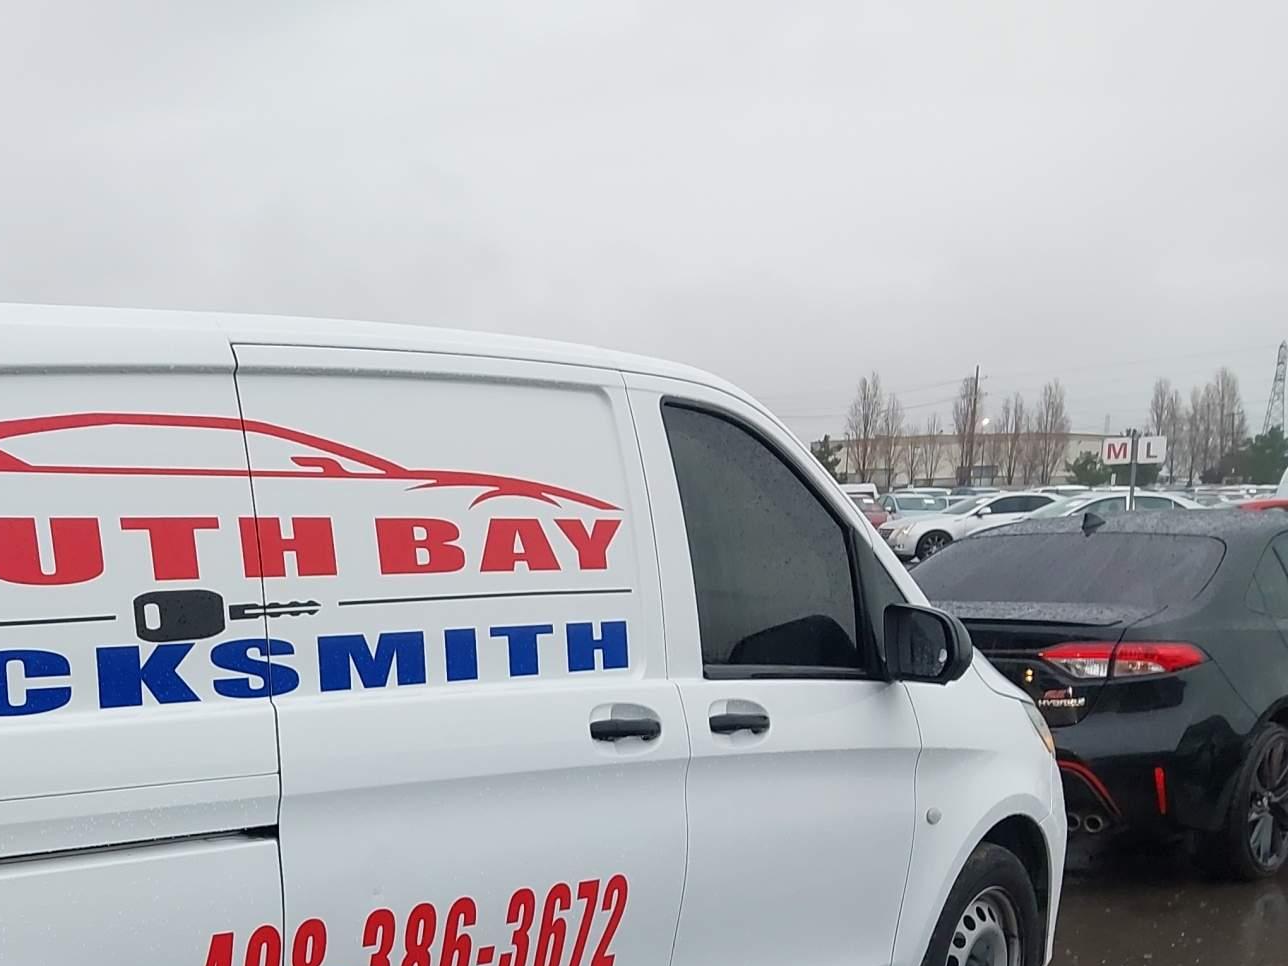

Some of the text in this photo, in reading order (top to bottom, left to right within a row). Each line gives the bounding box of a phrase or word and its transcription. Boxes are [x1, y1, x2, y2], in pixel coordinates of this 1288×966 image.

[1107, 442, 1128, 459] M
[1146, 441, 1158, 459] L
[375, 518, 620, 576] BAY
